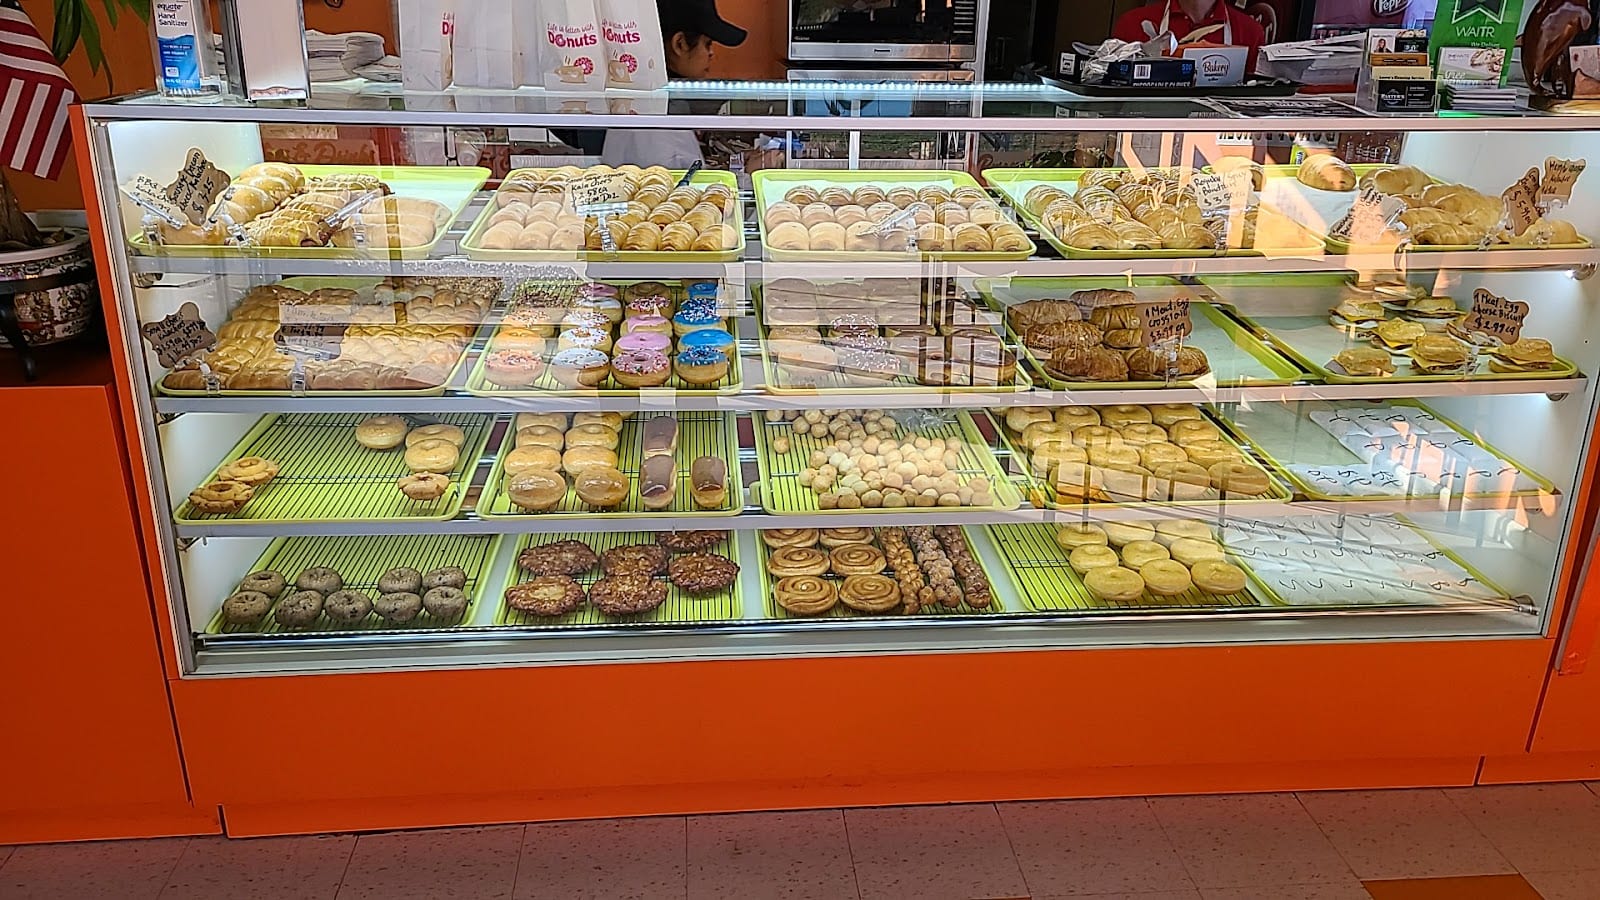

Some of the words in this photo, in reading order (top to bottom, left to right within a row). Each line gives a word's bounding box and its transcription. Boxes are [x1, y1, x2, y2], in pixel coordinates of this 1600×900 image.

[159, 19, 188, 27] Sanitizer
[1455, 26, 1495, 38] WAITR
[547, 31, 597, 48] Donuts
[1203, 61, 1229, 77] Bakery
